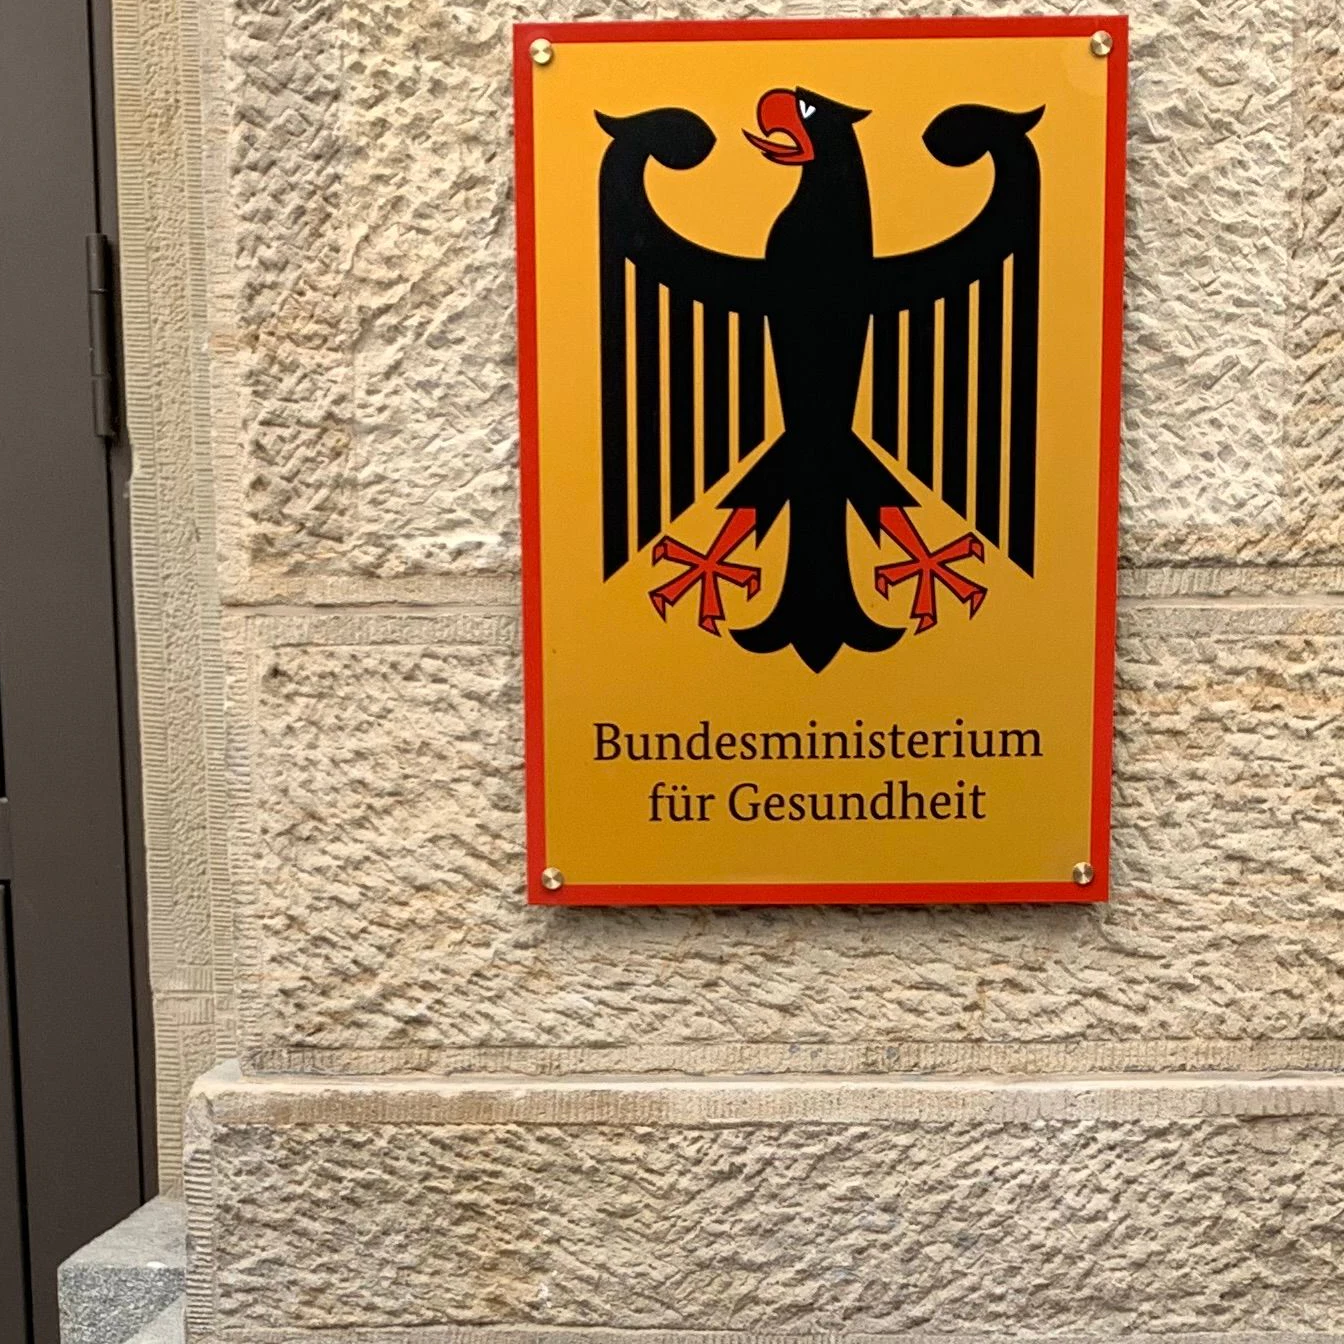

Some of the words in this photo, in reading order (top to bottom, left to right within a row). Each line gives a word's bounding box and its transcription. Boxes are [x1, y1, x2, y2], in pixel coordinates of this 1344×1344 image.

[592, 718, 1044, 762] Bundesministerium
[648, 781, 716, 822] für
[728, 779, 987, 822] Gesundheit
